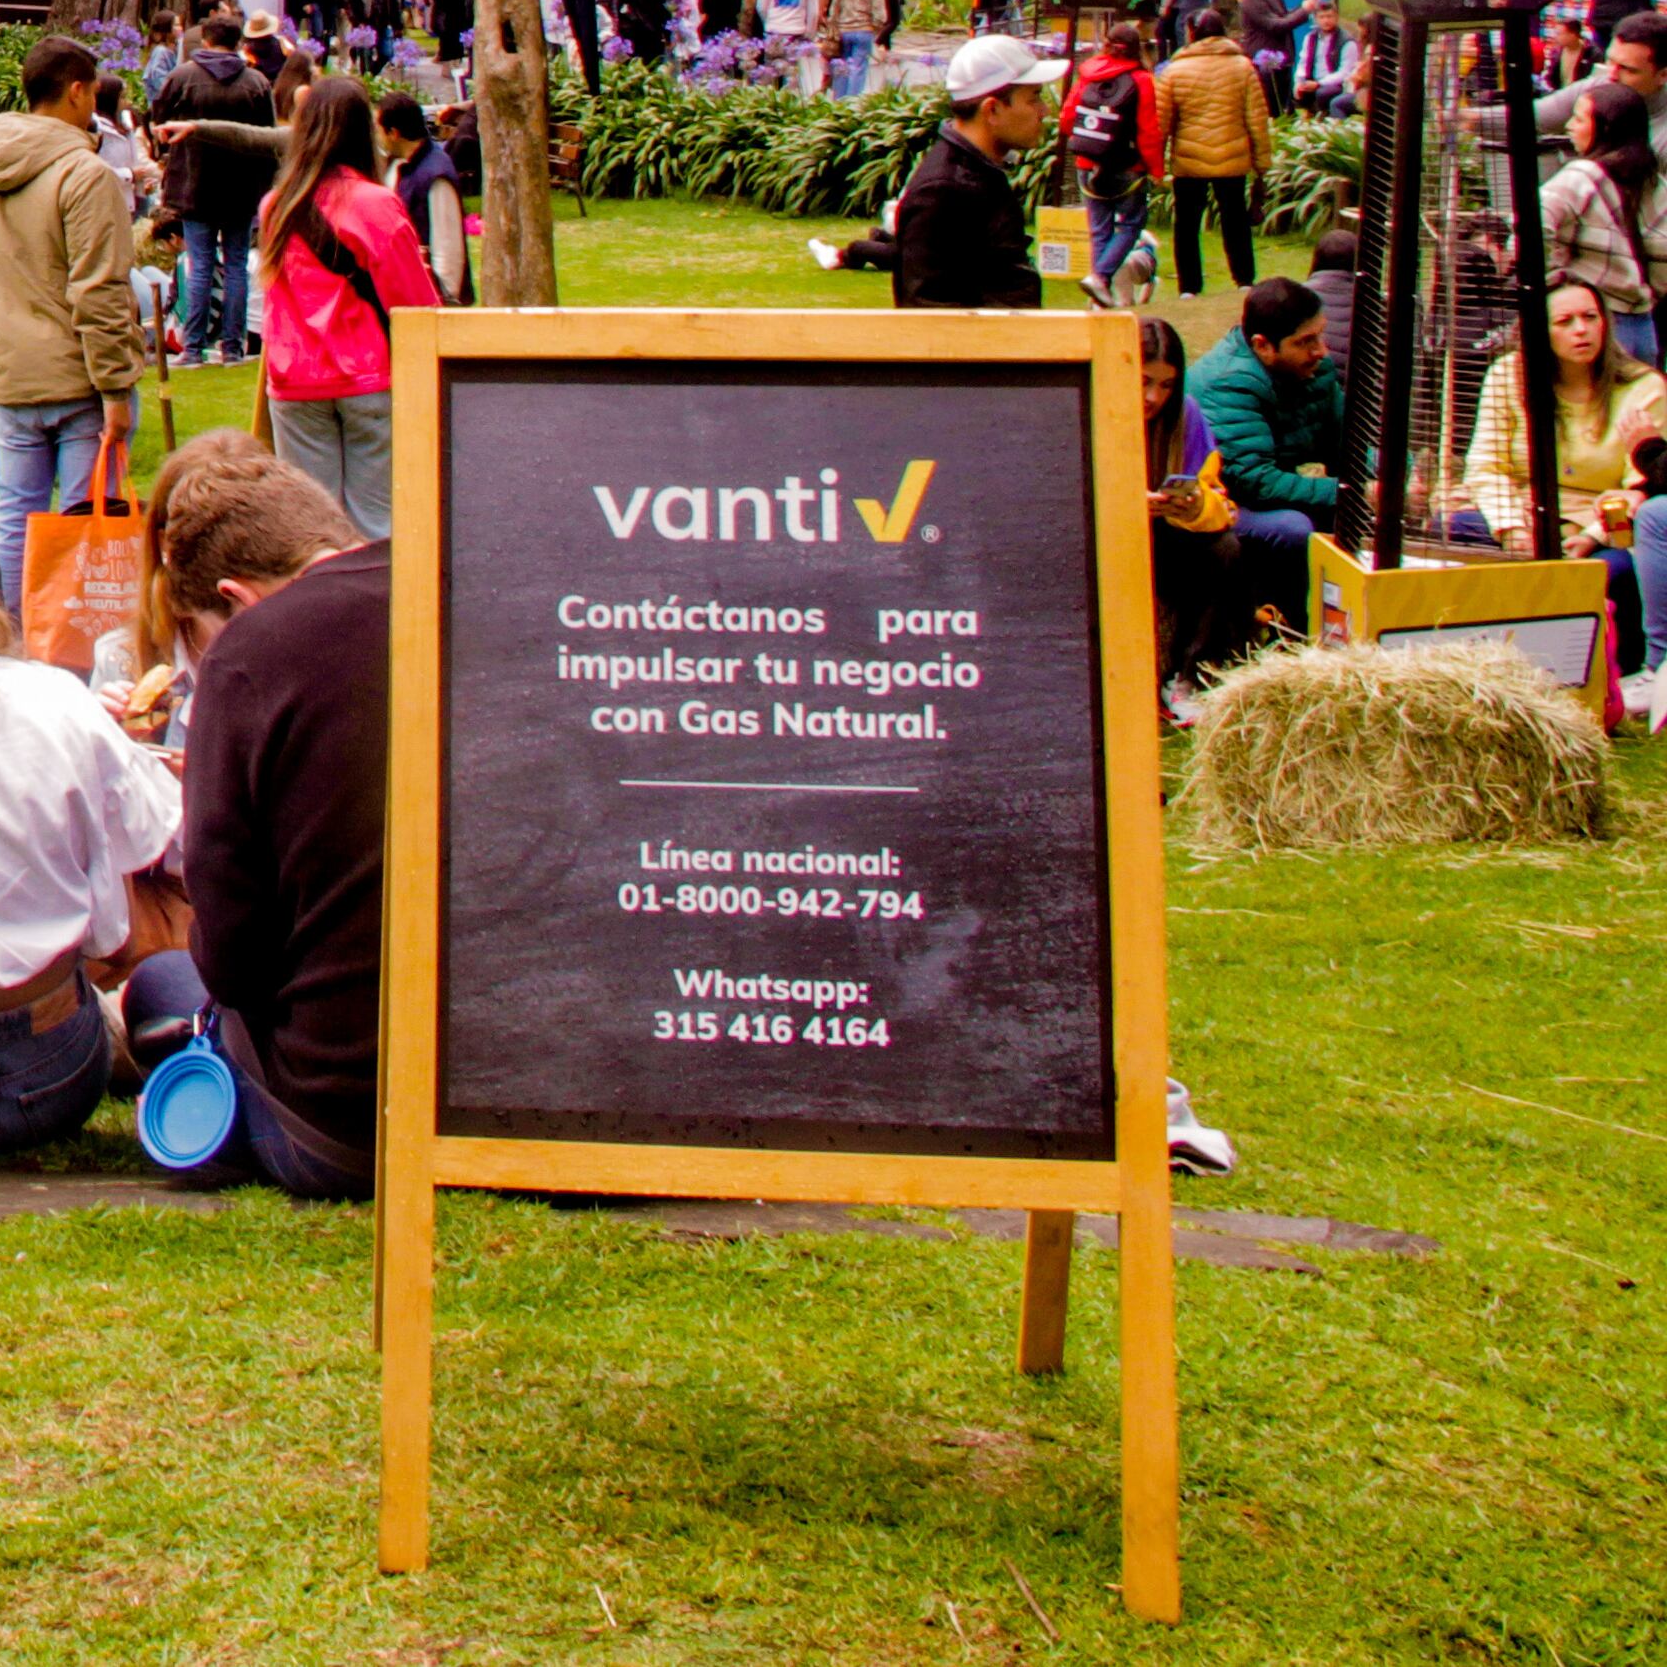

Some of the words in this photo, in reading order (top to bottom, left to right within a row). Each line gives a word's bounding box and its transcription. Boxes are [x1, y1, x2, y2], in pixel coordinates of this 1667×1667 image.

[593, 468, 842, 542] vanti
[557, 594, 825, 634] Contáctanos
[878, 608, 978, 643] para
[557, 646, 742, 690] impulsar
[754, 652, 799, 685] tu
[813, 653, 980, 695] negocio
[591, 706, 665, 733] con
[678, 700, 760, 735] Gas
[773, 702, 948, 740] Natural.
[640, 839, 734, 872] Línea
[743, 844, 902, 877] nacional:
[617, 883, 925, 920] 01-8000-942-794
[673, 968, 869, 1010] Whatsapp:
[653, 1010, 719, 1041] 315
[727, 1013, 794, 1043] 416
[802, 1016, 891, 1047] 4164
